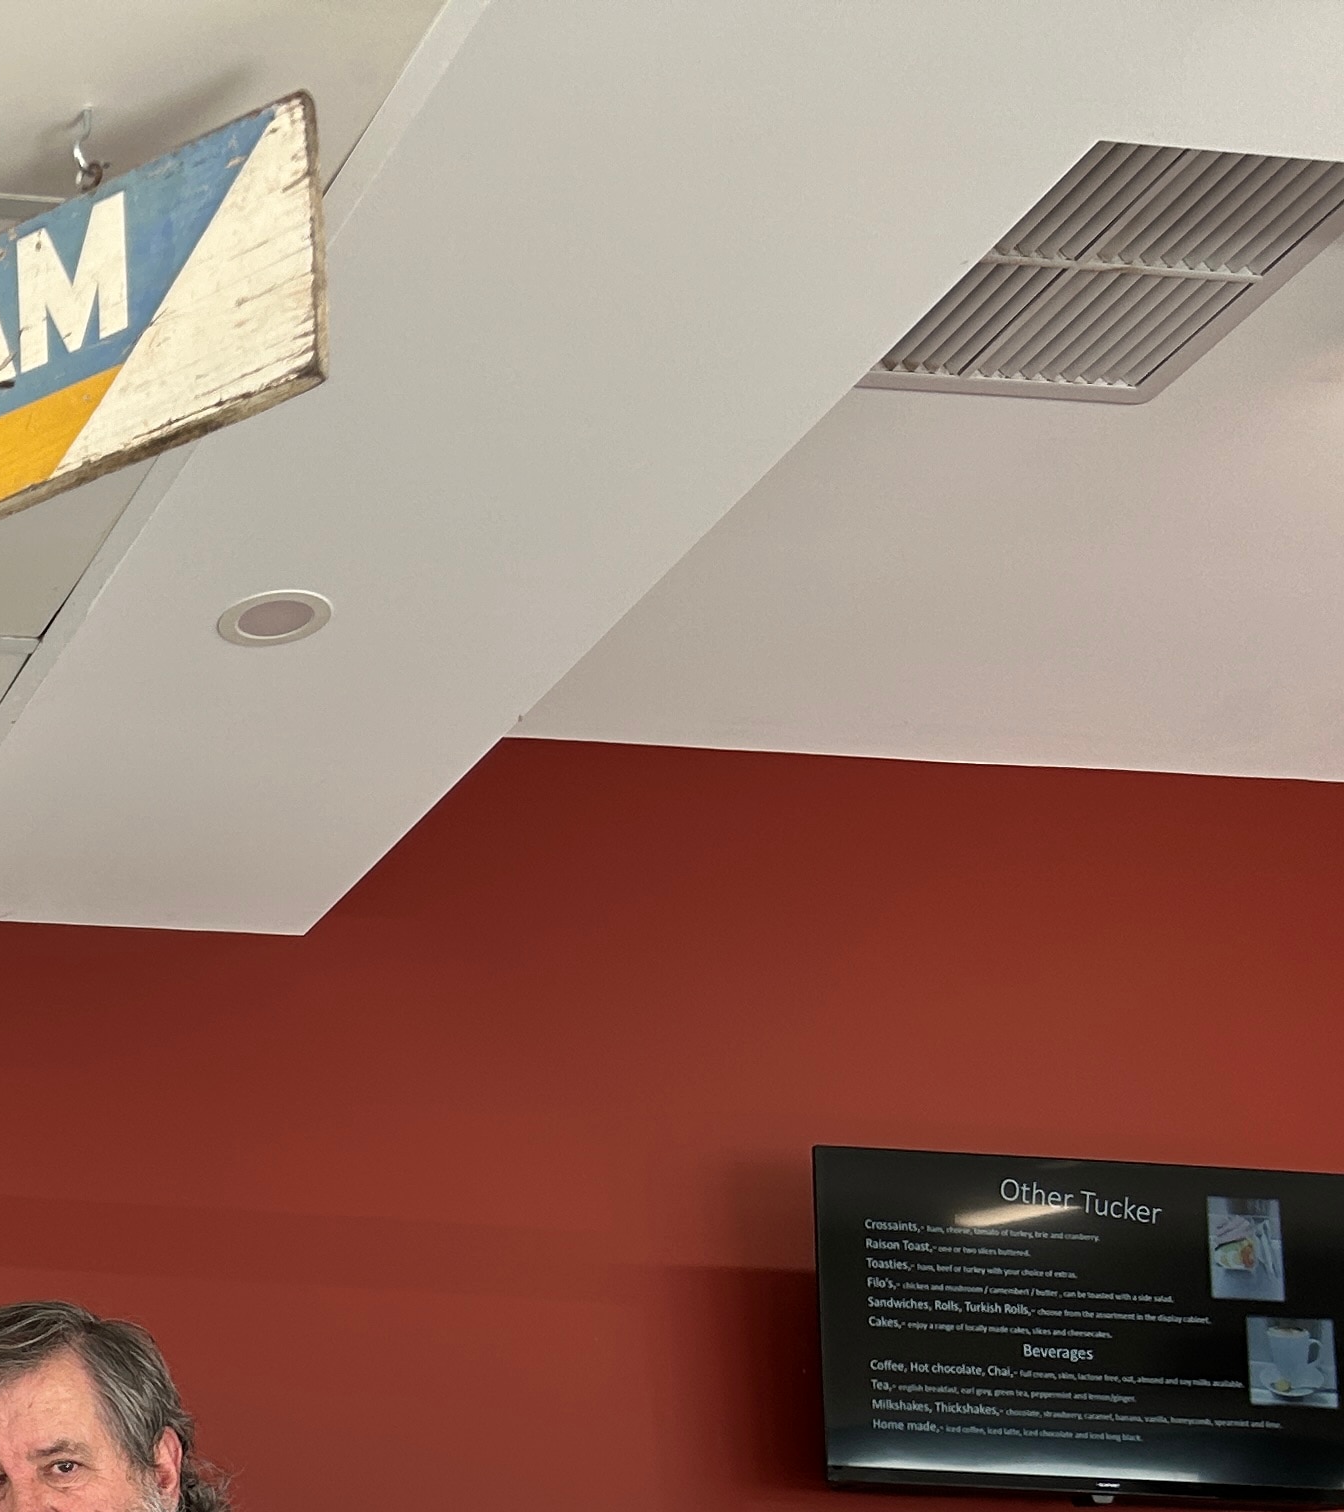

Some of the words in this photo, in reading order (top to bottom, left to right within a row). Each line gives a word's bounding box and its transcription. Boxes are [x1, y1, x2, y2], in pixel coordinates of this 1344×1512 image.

[1000, 1178, 1074, 1210] Other
[1080, 1190, 1163, 1225] Tucker
[865, 1238, 900, 1250] Raison
[867, 1296, 932, 1311] Sandwiches,
[934, 1300, 962, 1313] Rolls,
[964, 1301, 1002, 1313] Turkish
[1023, 1343, 1094, 1362] Beverages
[870, 1359, 908, 1373] Coffee,
[910, 1361, 930, 1373] Hot
[931, 1362, 986, 1377] chocolate,
[872, 1399, 932, 1414] Milkshakes,
[872, 1418, 904, 1430] Home
